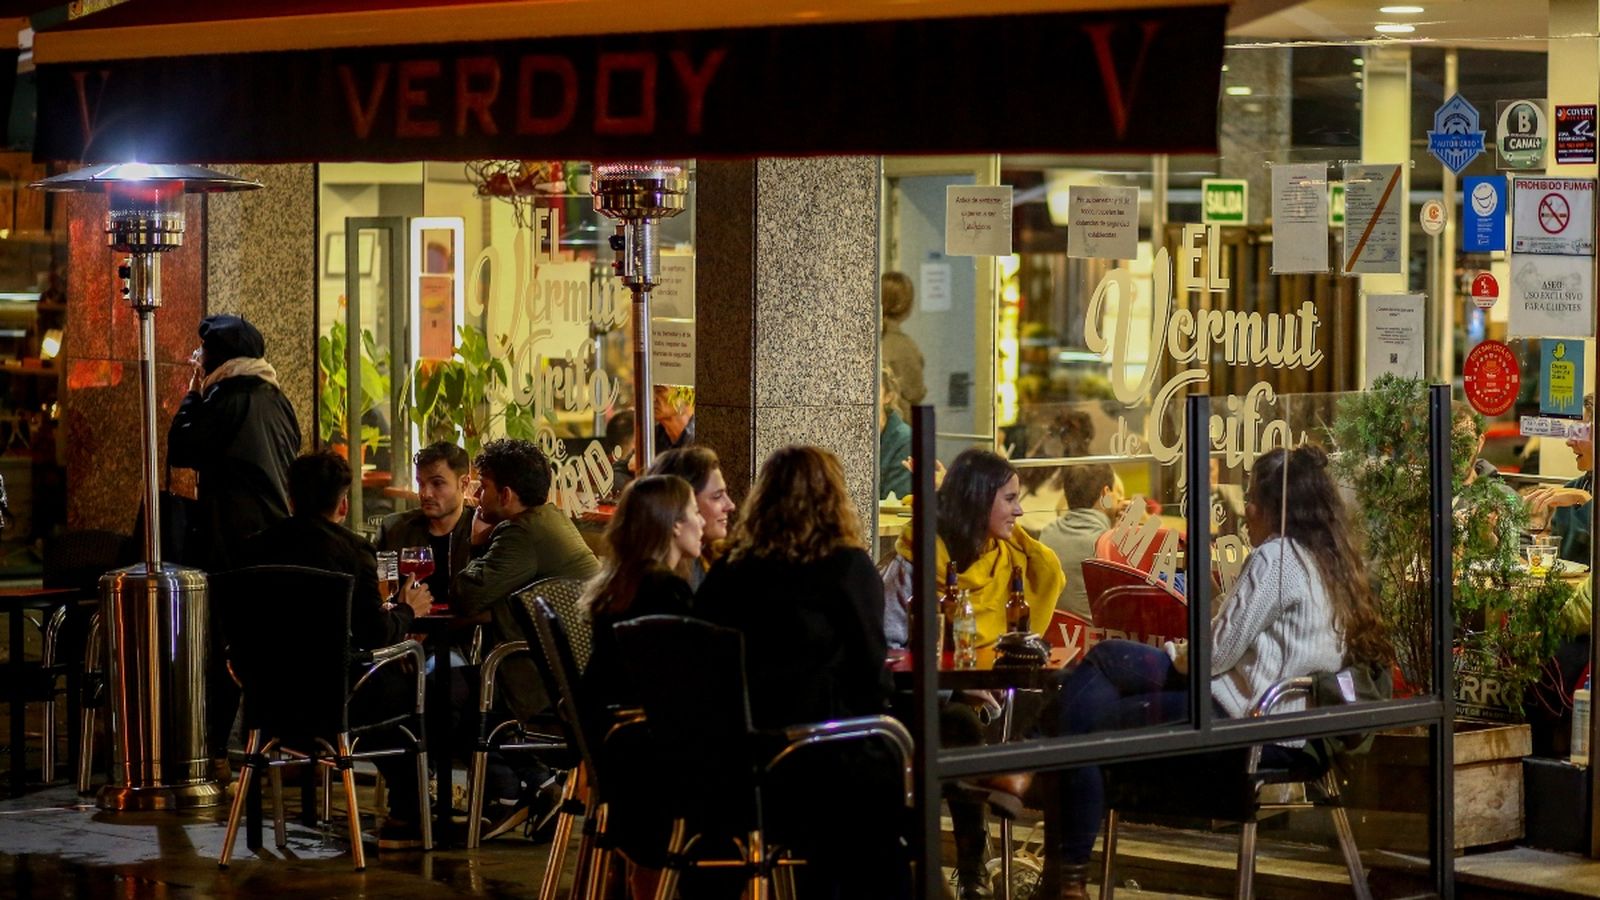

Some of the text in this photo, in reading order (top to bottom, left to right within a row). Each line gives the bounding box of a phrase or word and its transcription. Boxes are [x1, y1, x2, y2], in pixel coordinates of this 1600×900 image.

[337, 49, 728, 139] VERDOY
[1436, 138, 1477, 148] AUTORIZADO
[1508, 138, 1541, 149] CANAL+
[1517, 111, 1532, 133] B
[1515, 180, 1594, 191] PROHIBIDO FUMAR
[534, 207, 567, 267] EL
[1182, 223, 1230, 292] EL
[467, 228, 631, 361] Vermut
[1523, 292, 1583, 301] USO EXCLUSIVO
[1524, 302, 1582, 312] PARA CLIENTES
[1084, 246, 1324, 409] Vermut
[512, 329, 620, 426] Grifo
[1110, 415, 1142, 459] de
